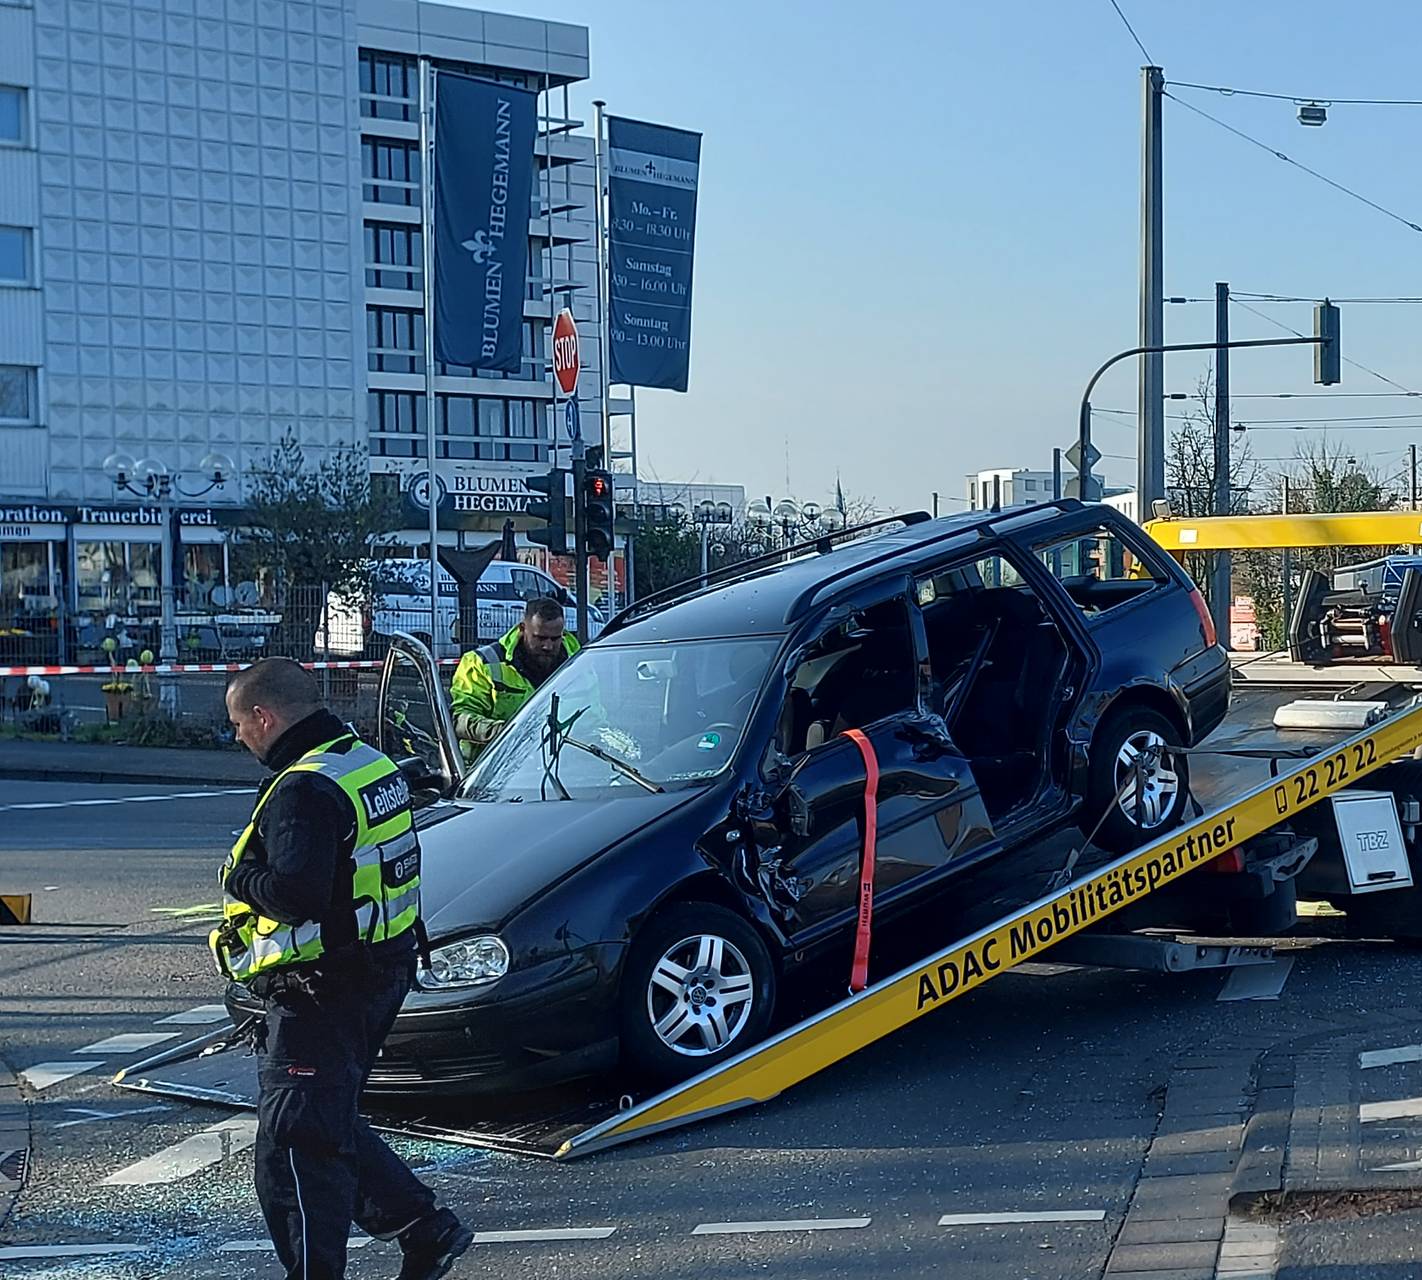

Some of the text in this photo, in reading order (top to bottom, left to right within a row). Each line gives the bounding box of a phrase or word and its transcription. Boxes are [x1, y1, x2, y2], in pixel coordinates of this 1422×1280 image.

[481, 98, 511, 358] BLUMEN HEGEMANN
[674, 227, 691, 240] Uhr
[625, 257, 672, 277] Samstag
[671, 282, 687, 295] Uhr
[624, 313, 669, 332] Sonntag
[667, 336, 687, 349] Uhr
[555, 335, 576, 371] STOP
[1356, 831, 1390, 852] TBZ
[916, 738, 1377, 1011] ADAC Mobilitätspartner 22 22 22
